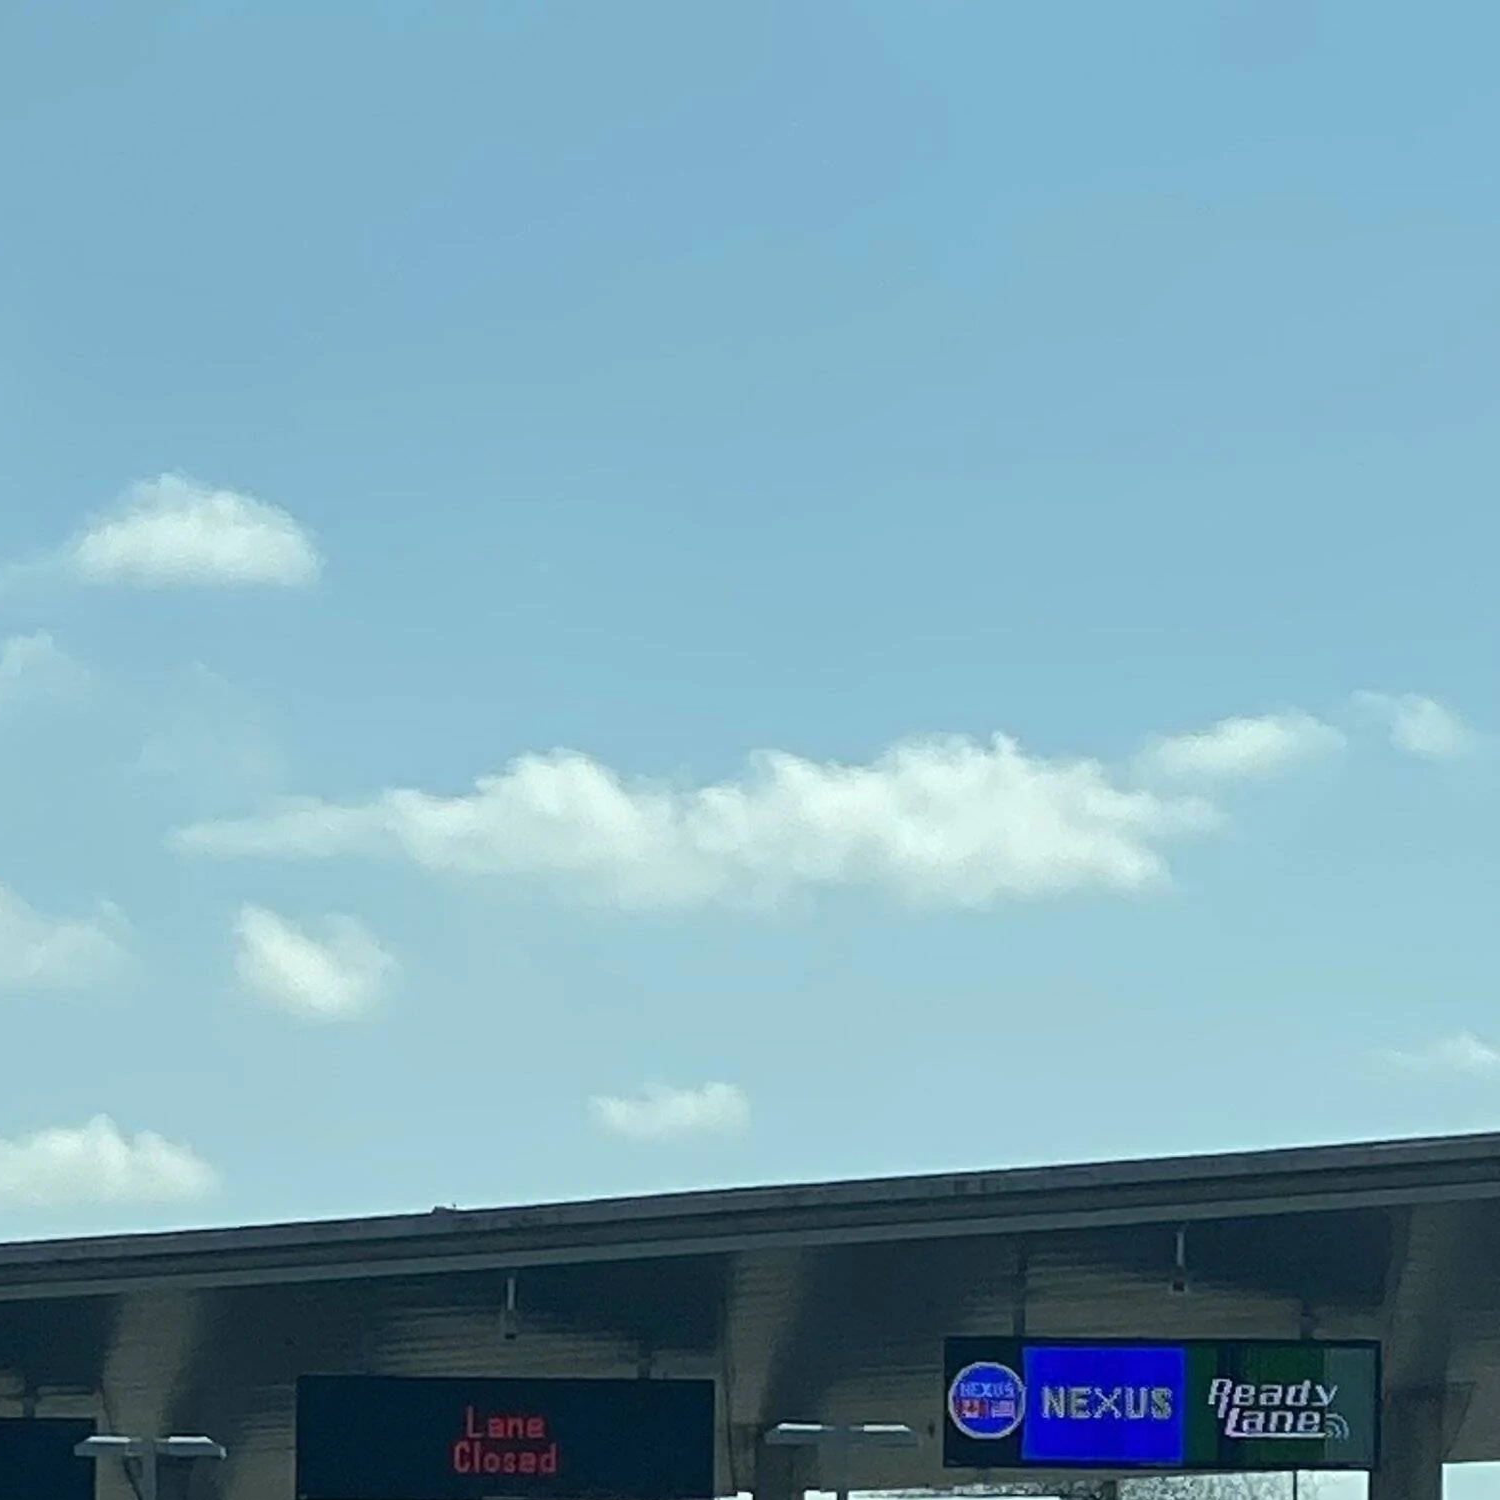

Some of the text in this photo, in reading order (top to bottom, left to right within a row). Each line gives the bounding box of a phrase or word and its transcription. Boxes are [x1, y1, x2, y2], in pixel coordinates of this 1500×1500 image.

[1041, 1385, 1173, 1420] NEXUS
[1207, 1378, 1338, 1418] Ready
[465, 1404, 546, 1438] Lane
[1224, 1407, 1327, 1438] Lane
[454, 1440, 557, 1474] Closed
